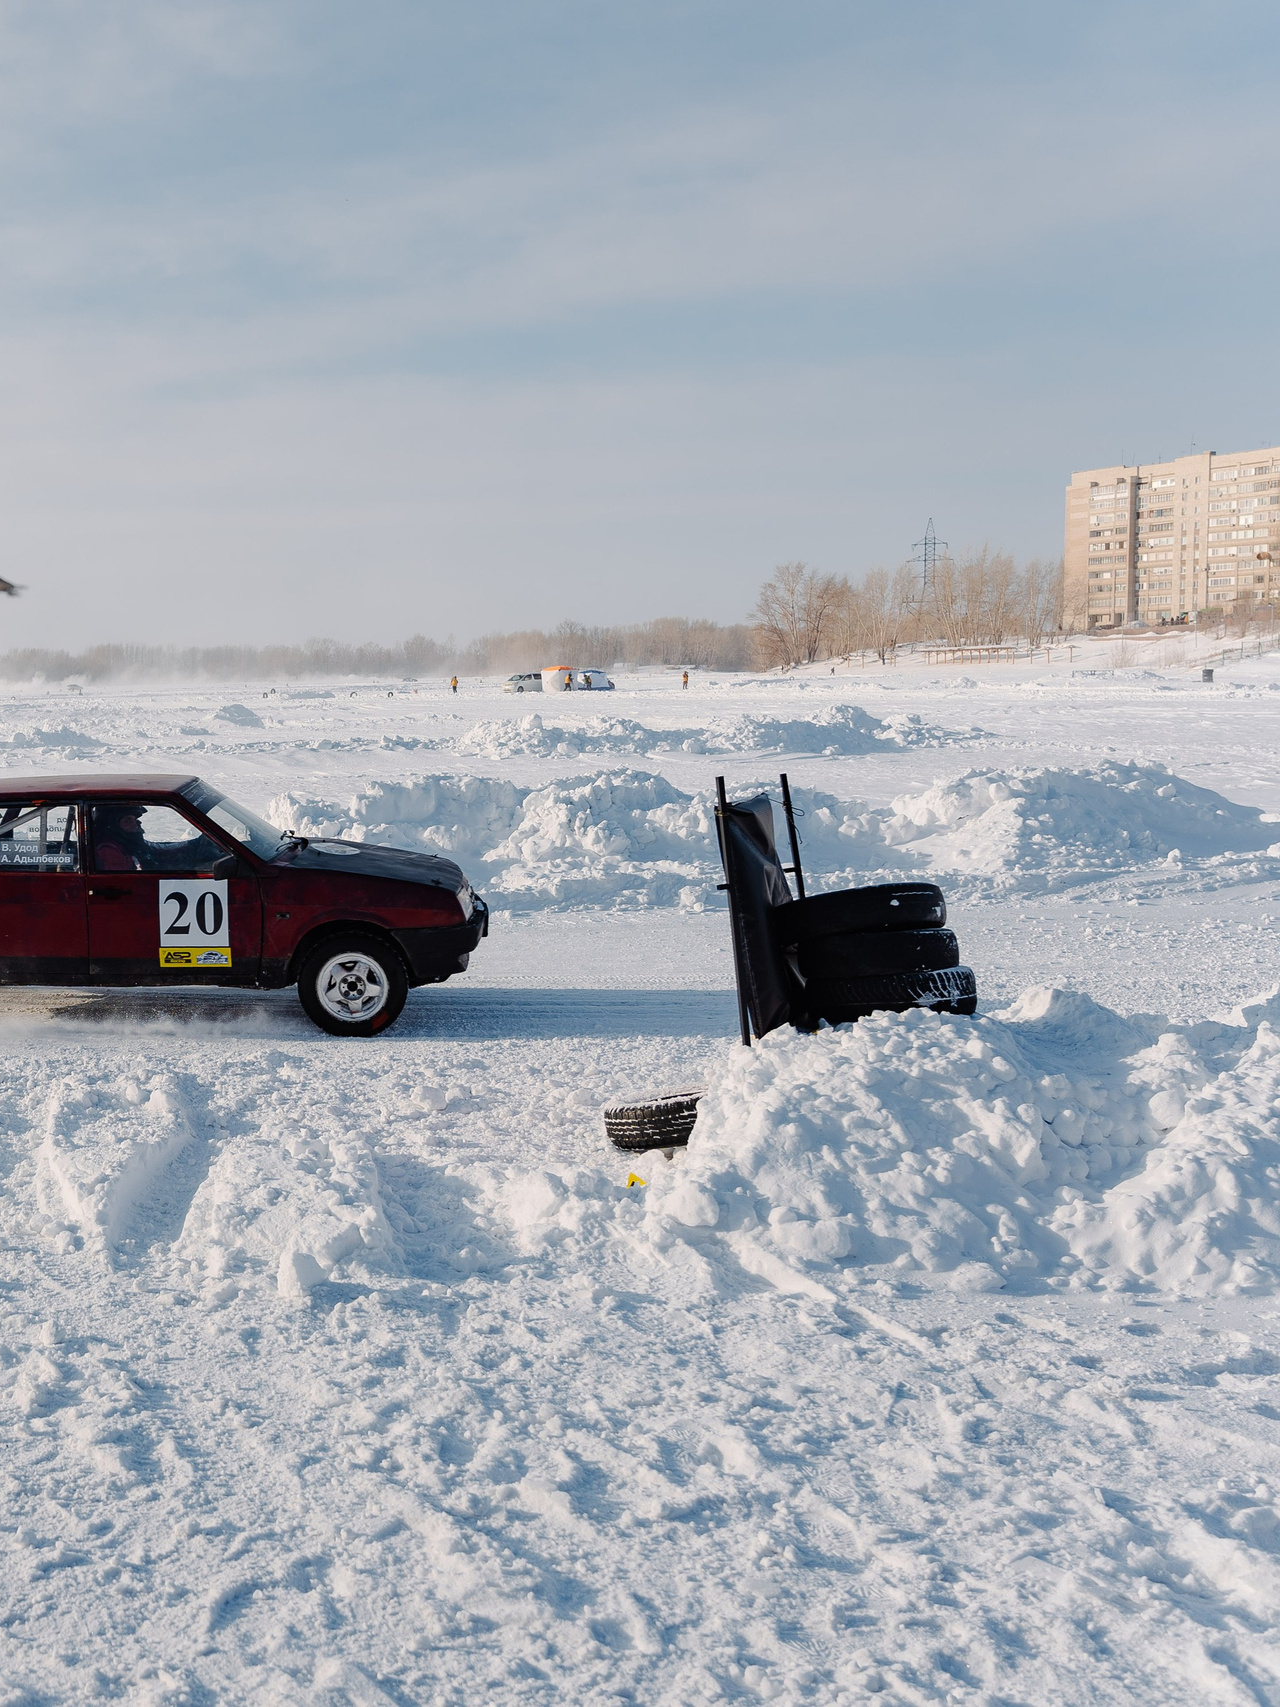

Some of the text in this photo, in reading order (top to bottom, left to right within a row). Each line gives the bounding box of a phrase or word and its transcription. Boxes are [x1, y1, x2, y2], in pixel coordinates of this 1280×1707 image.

[1, 843, 39, 853] В. Удод
[0, 854, 71, 864] А. Адылбеков
[163, 891, 224, 936] 20
